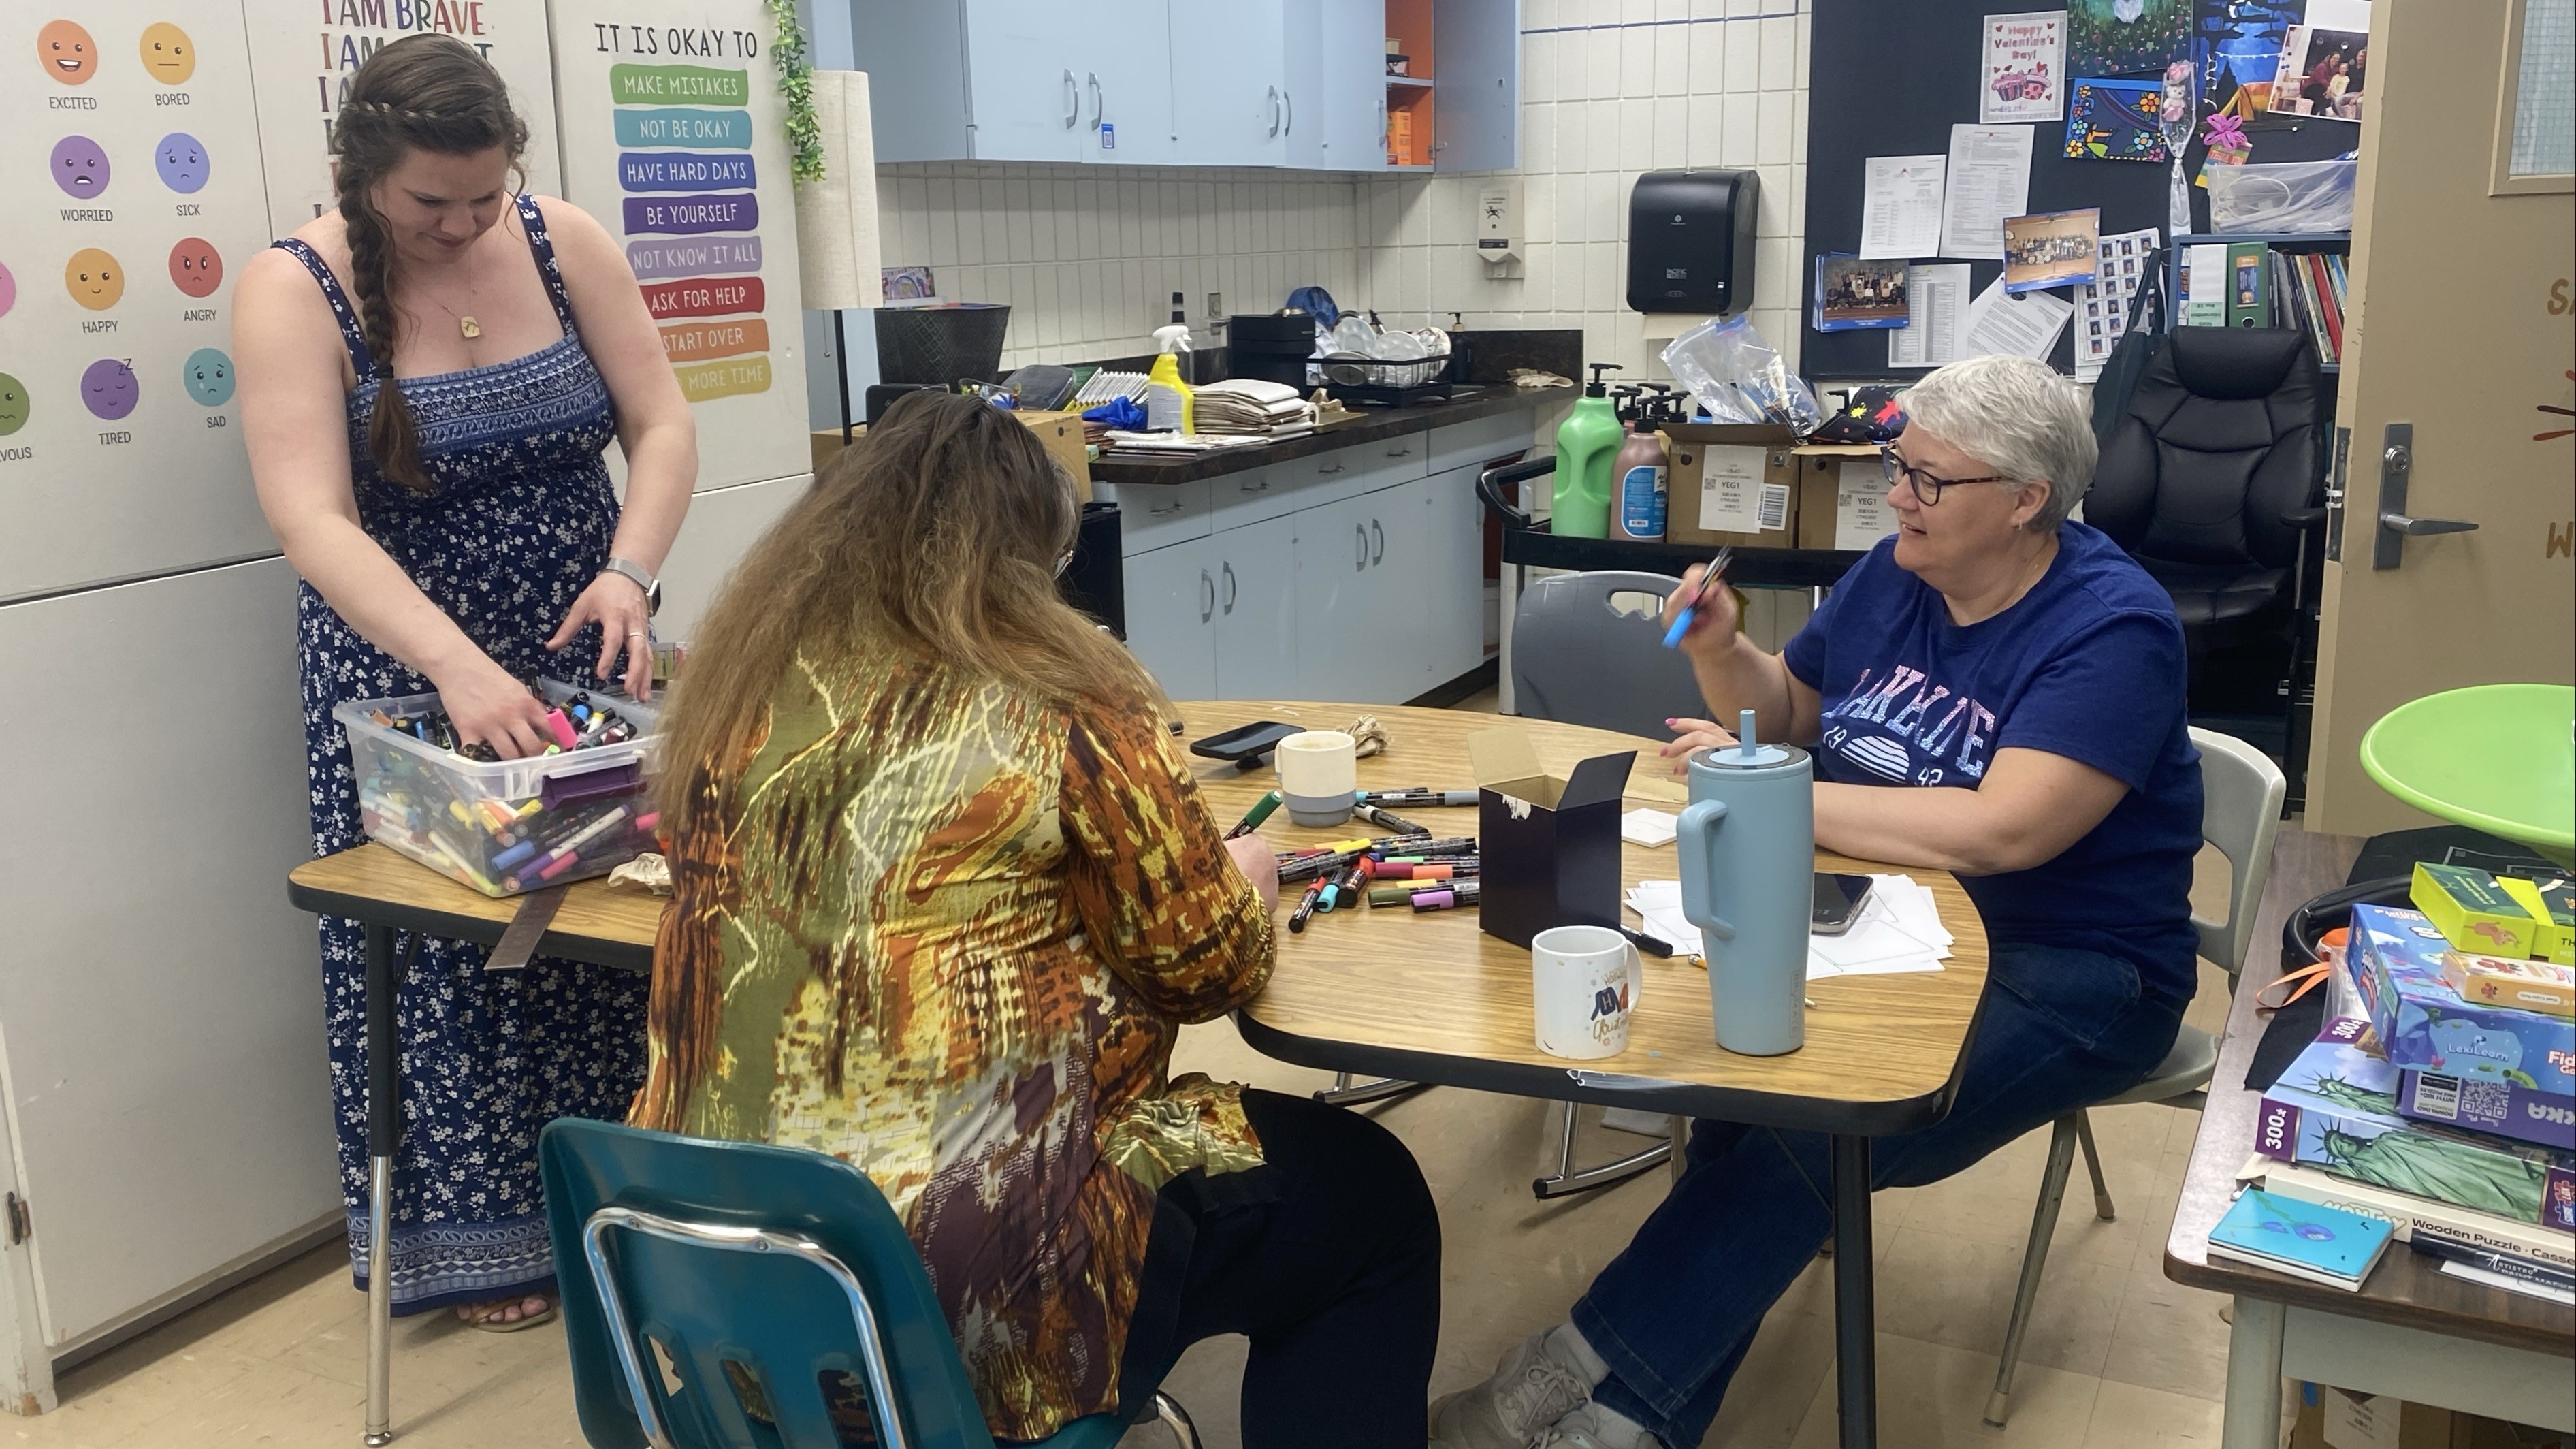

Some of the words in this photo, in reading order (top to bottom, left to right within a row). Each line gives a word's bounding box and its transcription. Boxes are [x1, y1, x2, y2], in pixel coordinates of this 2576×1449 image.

[340, 0, 387, 29] AM
[396, 0, 485, 35] BRAVE
[2008, 25, 2043, 36] Happy
[594, 22, 619, 52] IT
[631, 25, 658, 54] IS
[668, 28, 724, 57] OKAY
[733, 31, 758, 58] TO
[1995, 35, 2055, 48] Valentine's
[321, 33, 332, 69] I
[2012, 50, 2037, 61] Day!
[318, 76, 329, 112] I
[624, 75, 664, 94] MAKE
[669, 76, 738, 96] MISTAKES
[49, 97, 97, 110] EXCITED
[155, 93, 190, 106] BORED
[640, 119, 666, 138] NOT
[672, 120, 688, 138] BE
[694, 119, 730, 138] OKAY
[627, 163, 664, 182] HAVE
[669, 163, 707, 181] HARD
[712, 161, 747, 180] DAYS
[60, 209, 113, 221] WORRIED
[176, 204, 201, 216] SICK
[647, 206, 664, 225] BE
[669, 203, 737, 224] YOURSELF
[633, 250, 660, 270] NOT
[666, 247, 707, 268] KNOW
[713, 246, 728, 264] IT
[734, 244, 757, 263] ALL
[651, 291, 679, 312] ASK
[683, 289, 711, 308] FOR
[715, 286, 746, 305] HELP
[184, 310, 217, 321] ANGRY
[82, 321, 118, 333] HAPPY
[663, 331, 702, 353] START
[708, 328, 745, 347] OVER
[688, 369, 726, 391] MORE
[731, 365, 764, 384] TIME
[206, 416, 226, 428] SAD
[99, 431, 131, 445] TIRED
[0, 447, 32, 462] VOUS
[2447, 1043, 2509, 1062] LexiLearn
[2436, 1095, 2455, 1103] WITH
[2417, 1106, 2453, 1117] DOWNLOAD
[2412, 1217, 2471, 1241] Wooden
[2473, 1233, 2522, 1253] Puzzle
